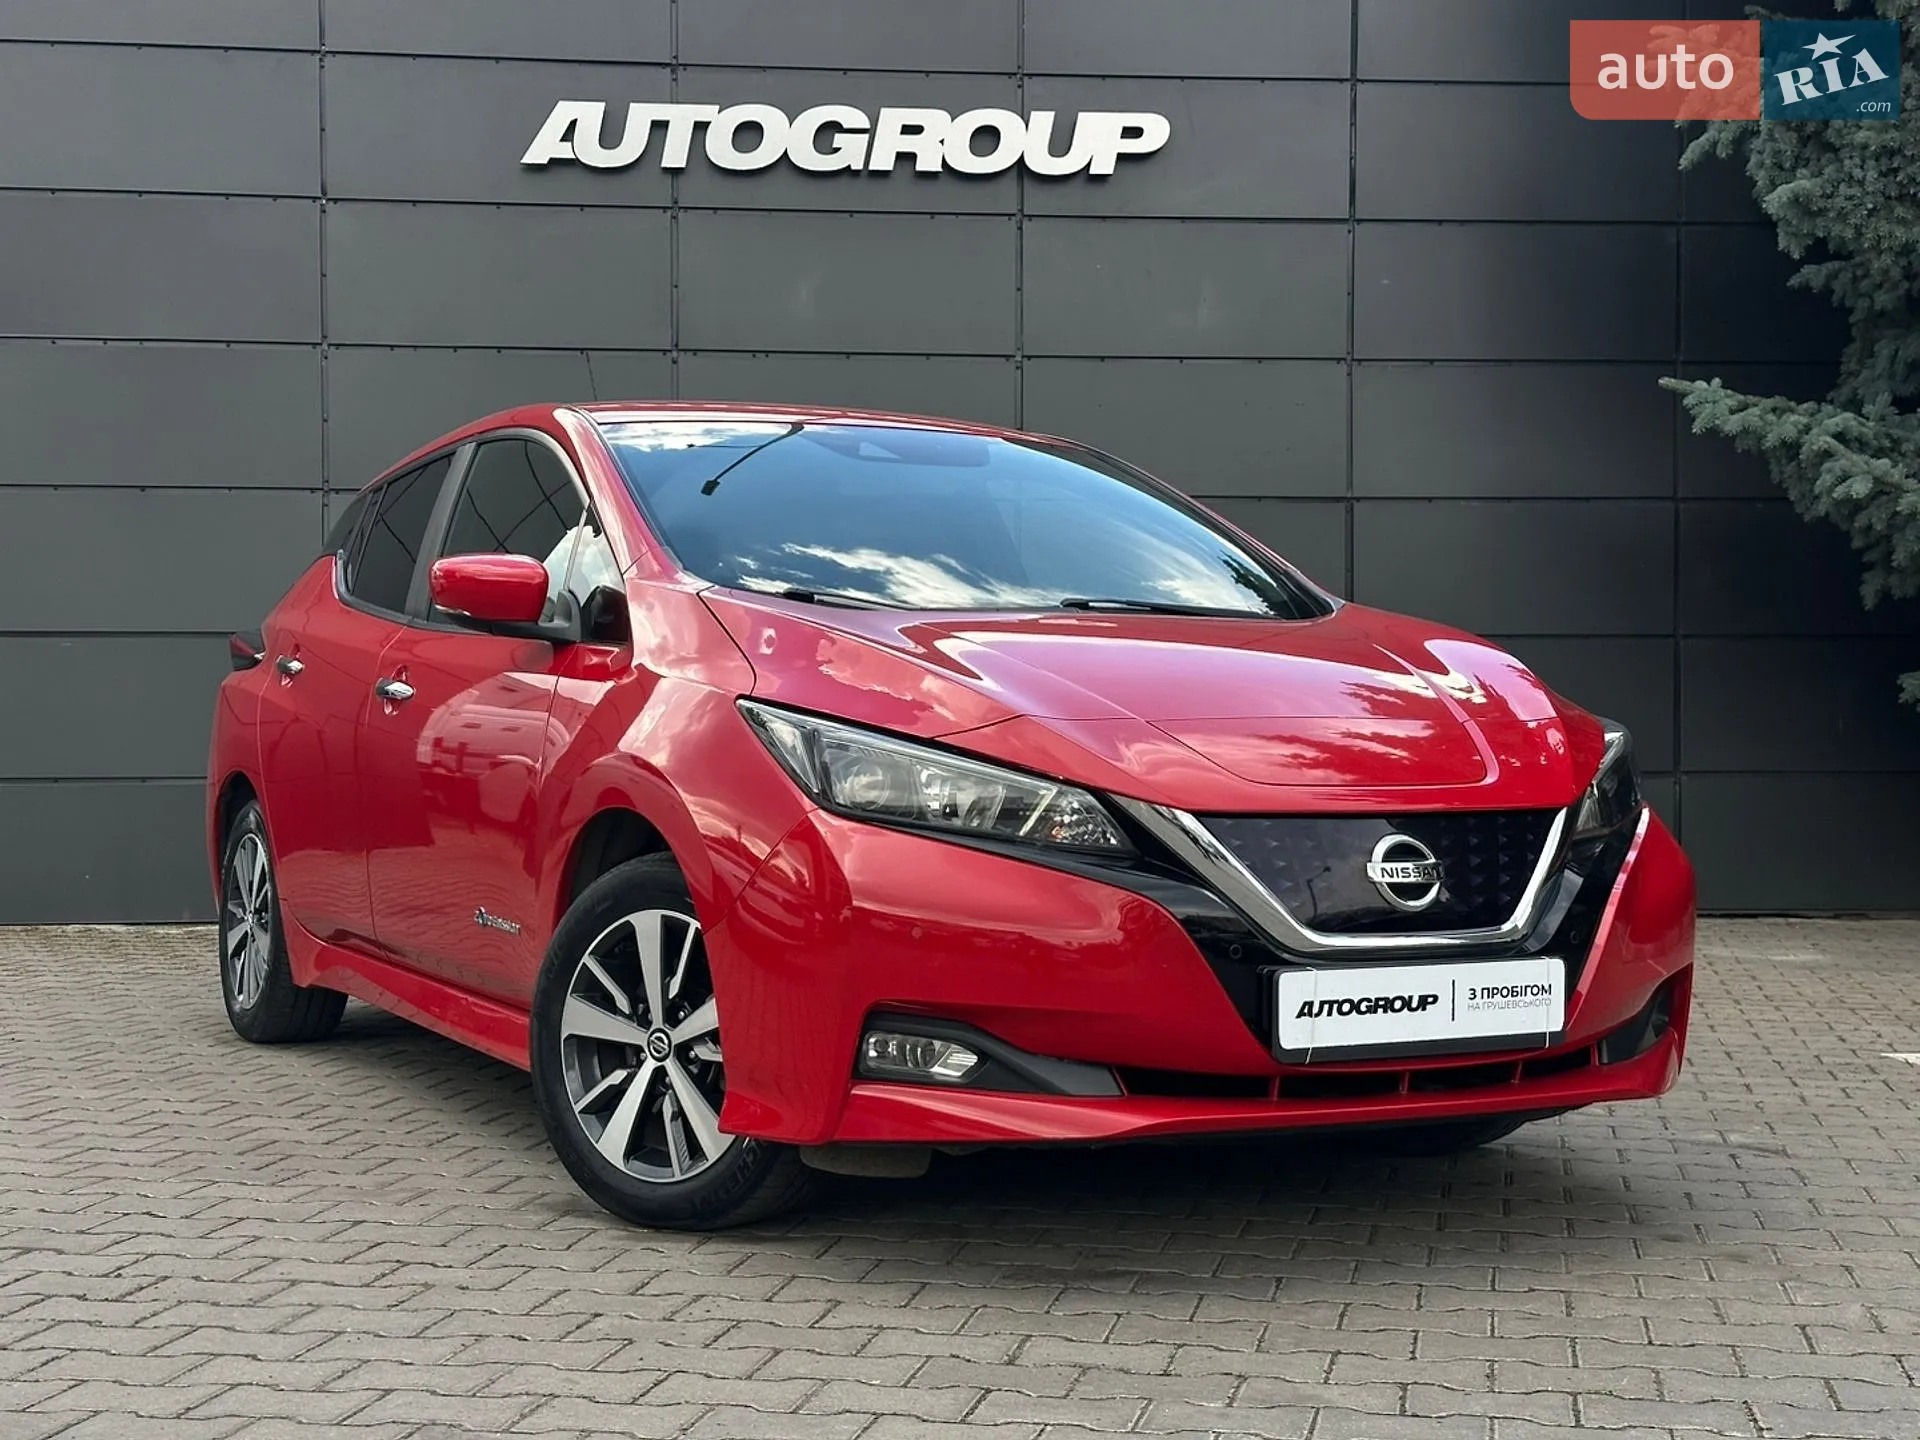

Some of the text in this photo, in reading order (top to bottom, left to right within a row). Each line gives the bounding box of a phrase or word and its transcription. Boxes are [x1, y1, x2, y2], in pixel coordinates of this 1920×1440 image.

[520, 100, 1171, 176] AUTOGROUP
[1380, 866, 1441, 880] NISSAN
[1480, 983, 1552, 1000] ПРОБІГОМ
[1295, 993, 1440, 1019] AUTOGROUP
